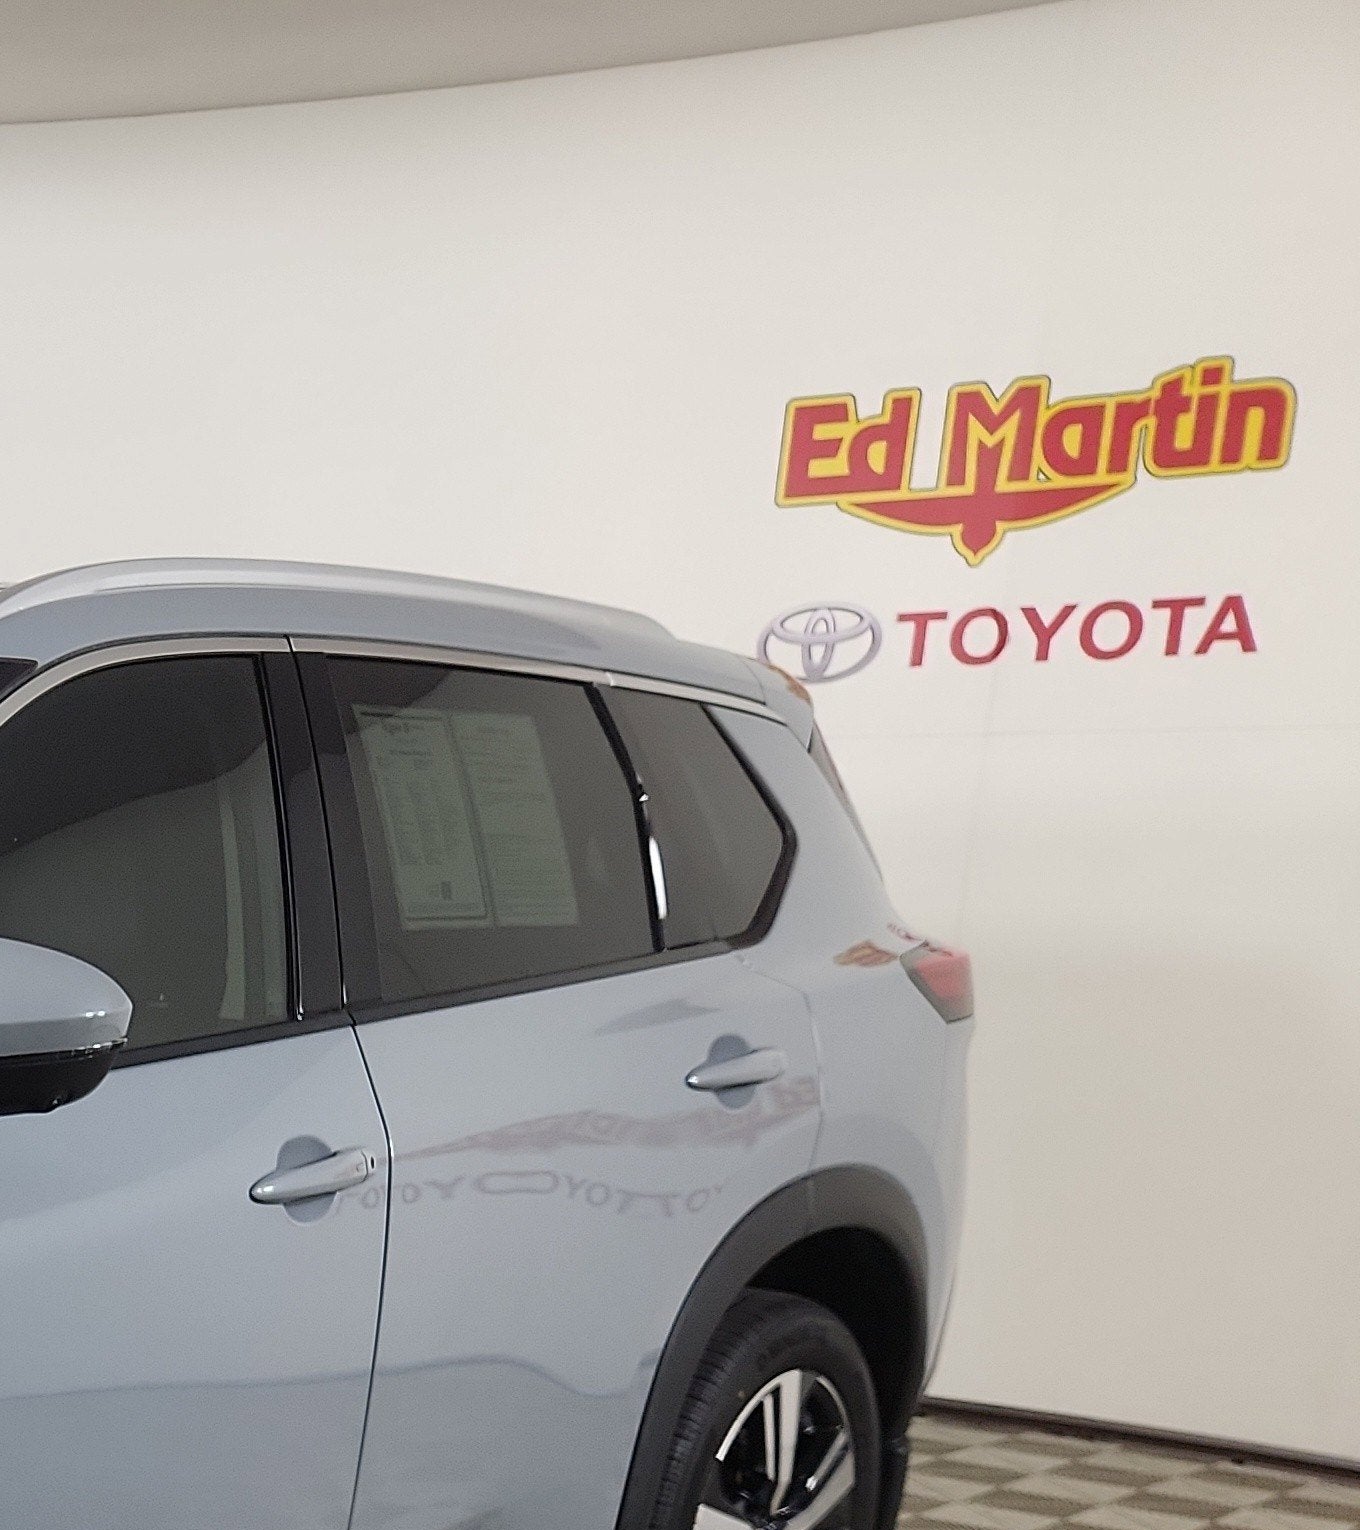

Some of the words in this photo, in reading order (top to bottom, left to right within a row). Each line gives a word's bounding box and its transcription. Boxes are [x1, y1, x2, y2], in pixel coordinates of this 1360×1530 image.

[775, 387, 922, 507] Ed
[940, 355, 1297, 495] Martin
[896, 594, 1259, 669] TOYOTA
